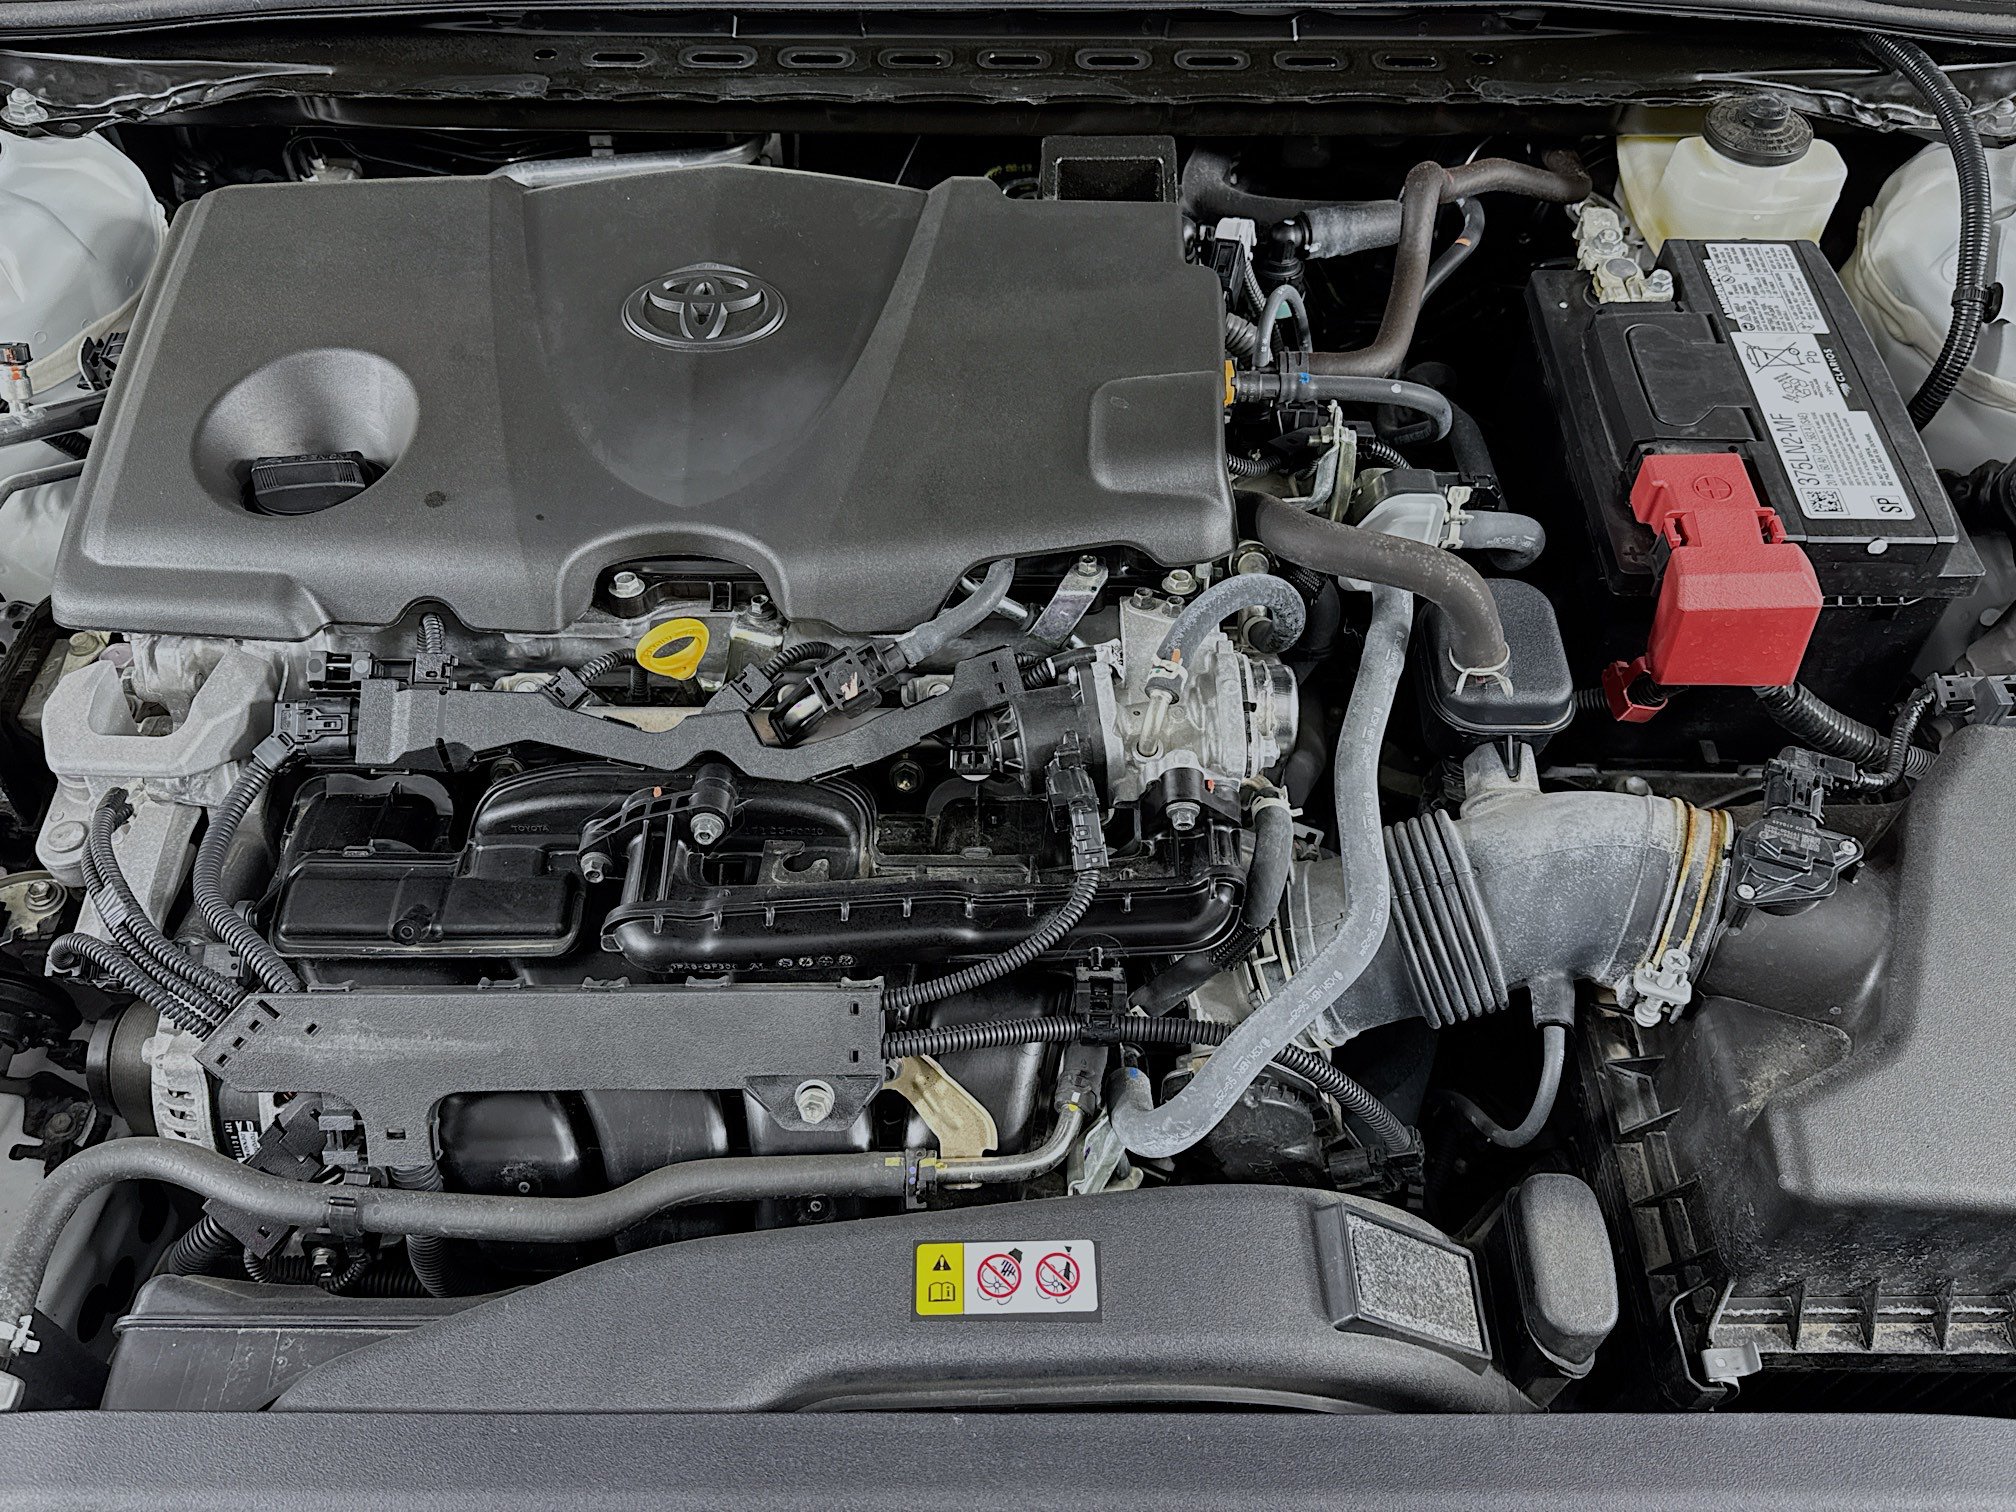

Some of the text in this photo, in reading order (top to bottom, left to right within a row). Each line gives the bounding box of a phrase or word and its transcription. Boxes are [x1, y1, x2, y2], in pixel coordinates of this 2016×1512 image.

[1804, 350, 1820, 364] Pb
[1823, 348, 1846, 382] CLARIOS
[1769, 412, 1821, 485] 375LN2-MF
[1875, 497, 1903, 512] SP
